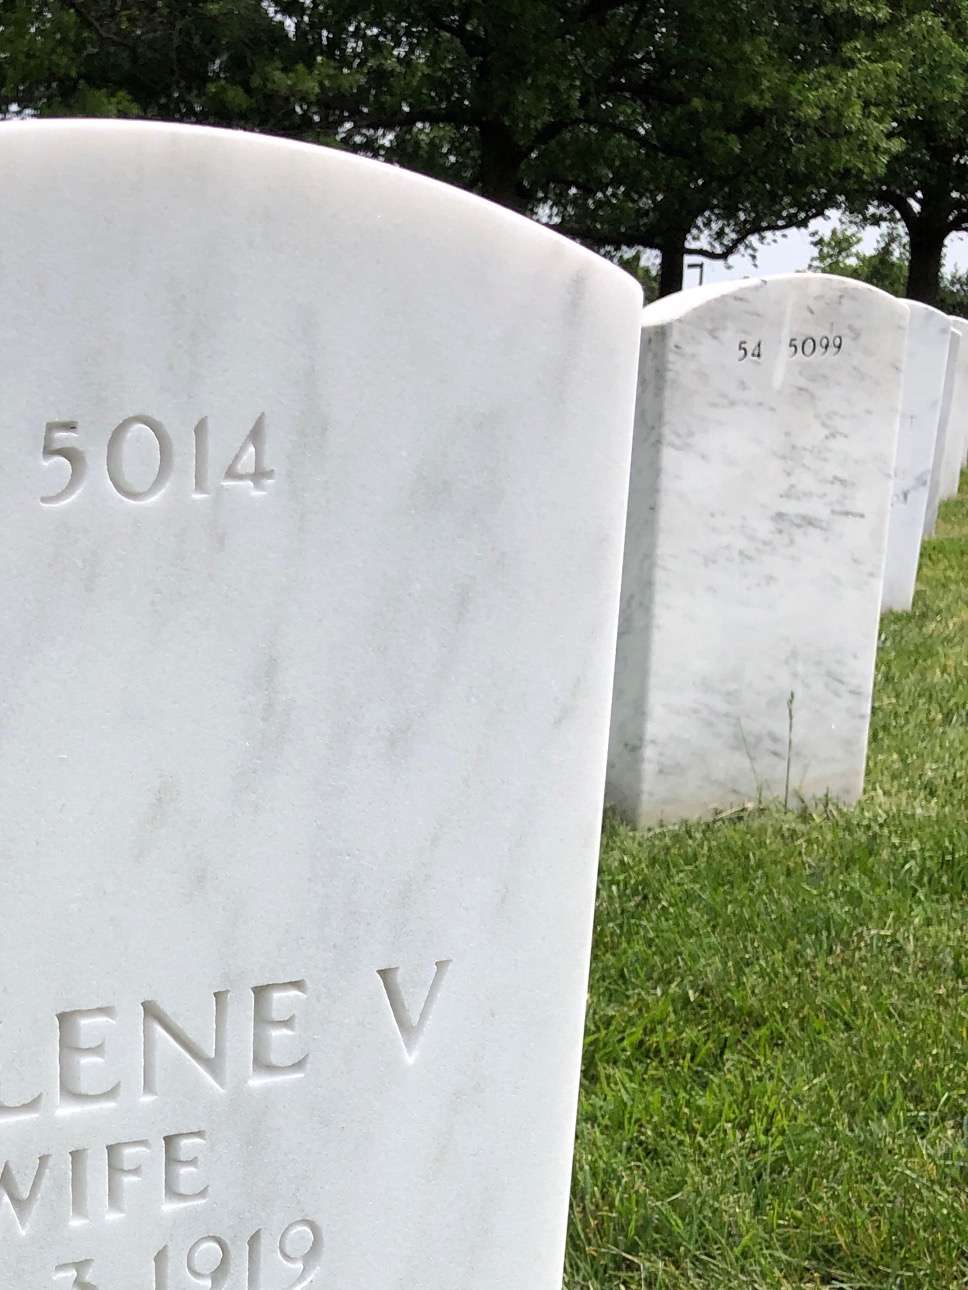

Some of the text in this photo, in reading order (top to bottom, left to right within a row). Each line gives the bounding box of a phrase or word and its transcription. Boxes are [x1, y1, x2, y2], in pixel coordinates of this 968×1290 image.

[737, 335, 843, 362] 54 5099
[39, 411, 276, 507] 5014
[375, 959, 453, 1064] V
